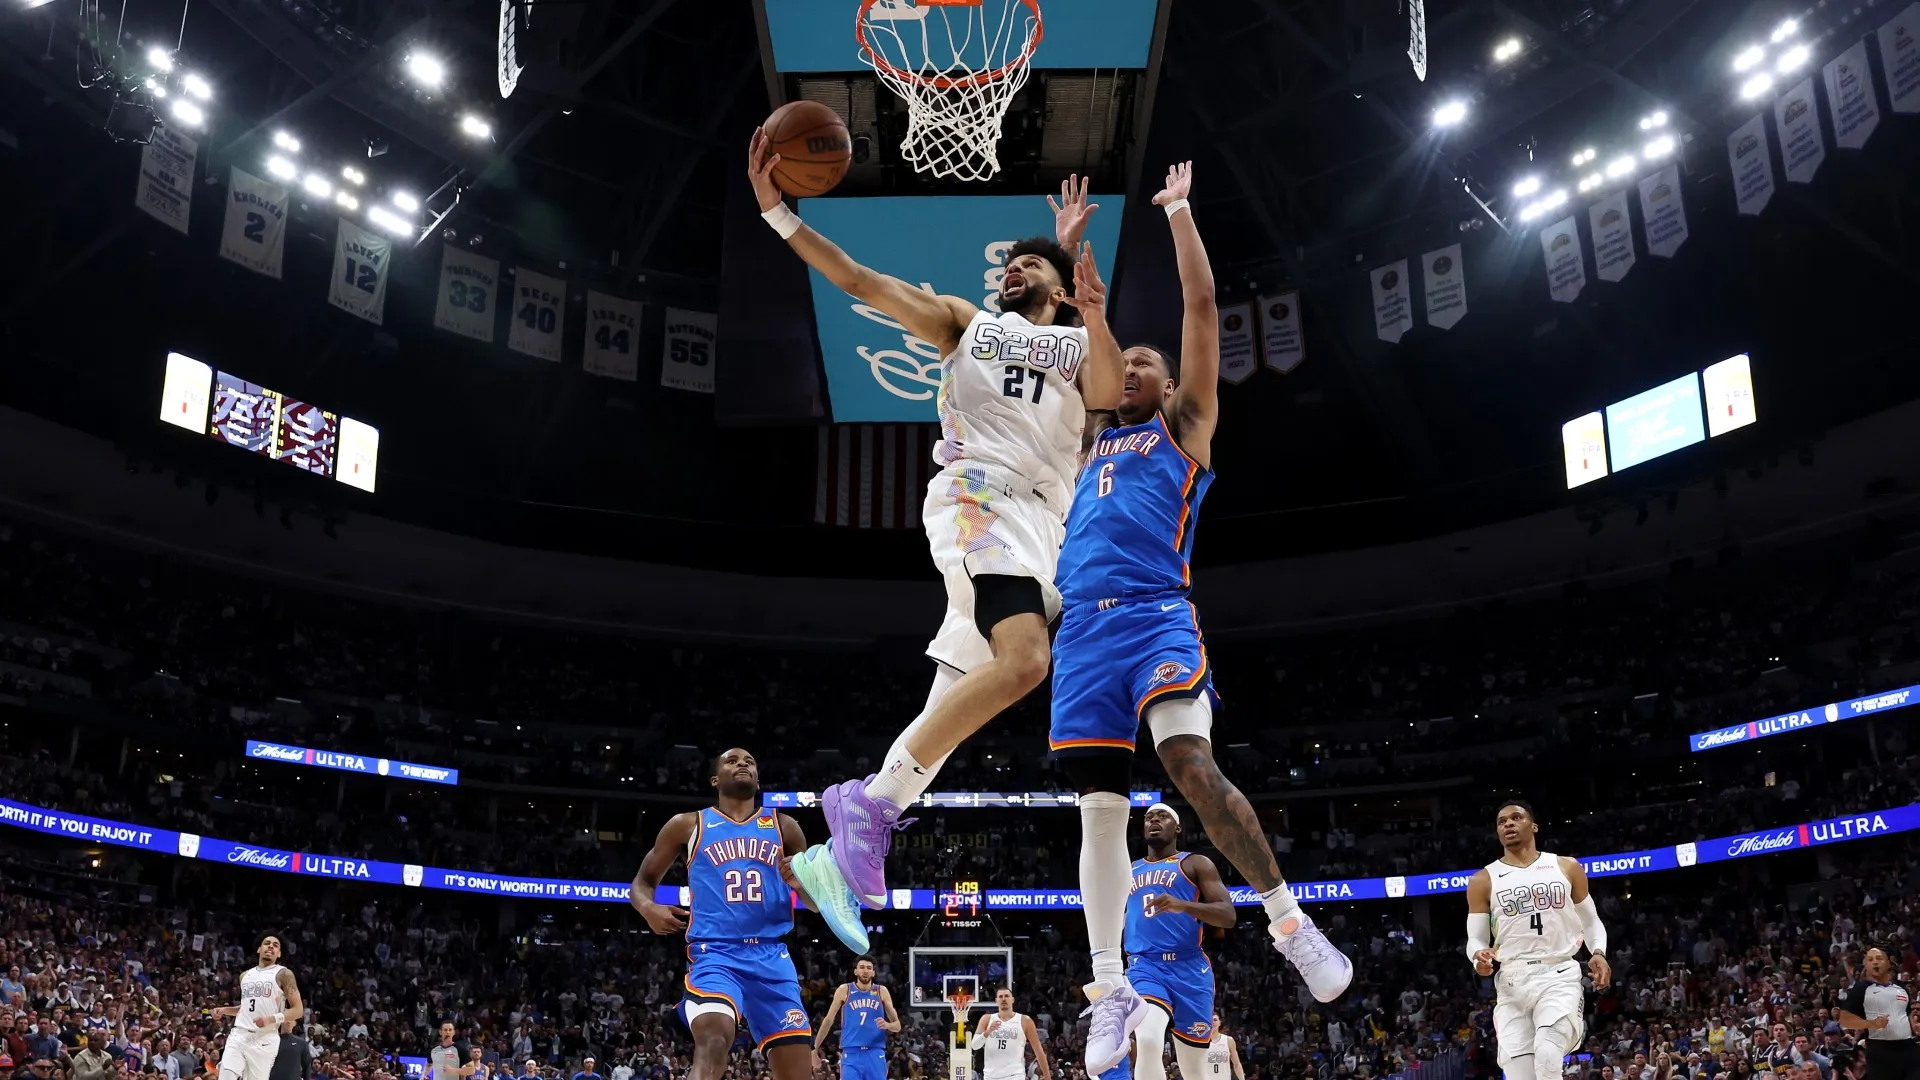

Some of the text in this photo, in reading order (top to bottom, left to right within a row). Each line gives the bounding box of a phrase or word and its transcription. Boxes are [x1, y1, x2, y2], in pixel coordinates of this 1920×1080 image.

[244, 212, 266, 244] 2
[345, 258, 377, 294] 12
[449, 280, 487, 314] 33
[518, 302, 556, 334] 40
[595, 325, 629, 353] 44
[671, 338, 708, 366] 55
[971, 323, 1082, 381] 5280
[1003, 366, 1046, 404] 27
[1098, 461, 1116, 498] 6
[1155, 665, 1177, 681] OKC
[1758, 713, 1812, 734] ULTRA
[316, 753, 365, 770] ULTRA
[0, 804, 152, 845] ORTH IT IF YOU ENJOY IT
[1728, 815, 1887, 857] Michelob ULTRA
[228, 846, 370, 878] Michelob ULTRA
[703, 838, 779, 866] THUNDER
[1592, 858, 1635, 873] ENJOY
[1639, 856, 1652, 867] IT
[444, 874, 631, 899] IT'S ONLY WORTH IT IF YOU ENJO
[724, 869, 763, 904] 22
[955, 882, 979, 895] 1:09
[1427, 876, 1449, 889] IT'S
[988, 895, 1031, 905] WORTH
[1035, 895, 1045, 905] IT
[1047, 895, 1058, 905] IF
[1496, 881, 1566, 917] 5280
[1530, 913, 1543, 936] 4
[1162, 952, 1176, 961] OKC
[241, 981, 273, 998] 5280
[249, 999, 255, 1012] 3
[849, 998, 880, 1011] THUNDER
[860, 1011, 867, 1025] 7
[998, 1040, 1006, 1050] 15
[955, 1067, 966, 1076] GET
[1213, 1064, 1219, 1073] 0
